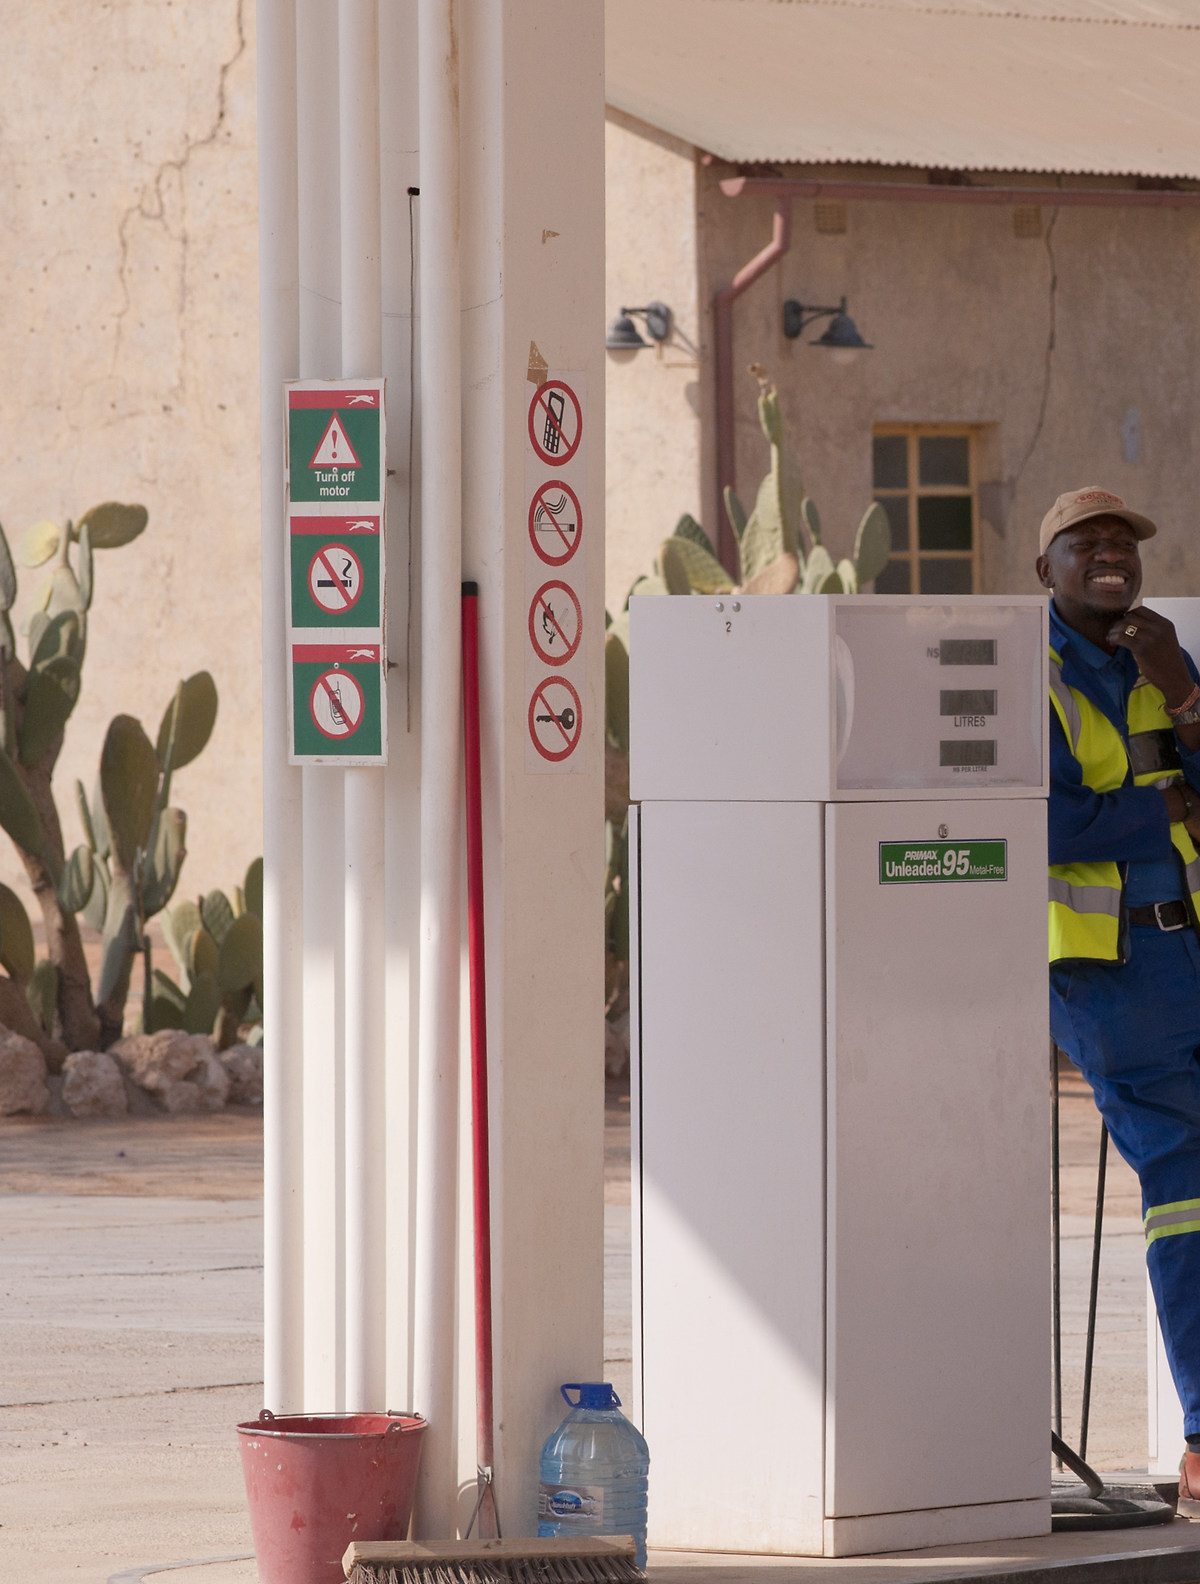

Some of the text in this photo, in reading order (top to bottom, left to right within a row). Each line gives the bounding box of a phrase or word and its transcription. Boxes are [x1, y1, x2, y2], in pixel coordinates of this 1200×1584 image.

[314, 471, 356, 482] Turn off
[319, 486, 350, 496] motor
[725, 621, 732, 633] 2
[954, 716, 986, 727] LITRES
[904, 850, 938, 861] PRIMAX
[885, 849, 1005, 877] Unleaded 95 Metal-Free
